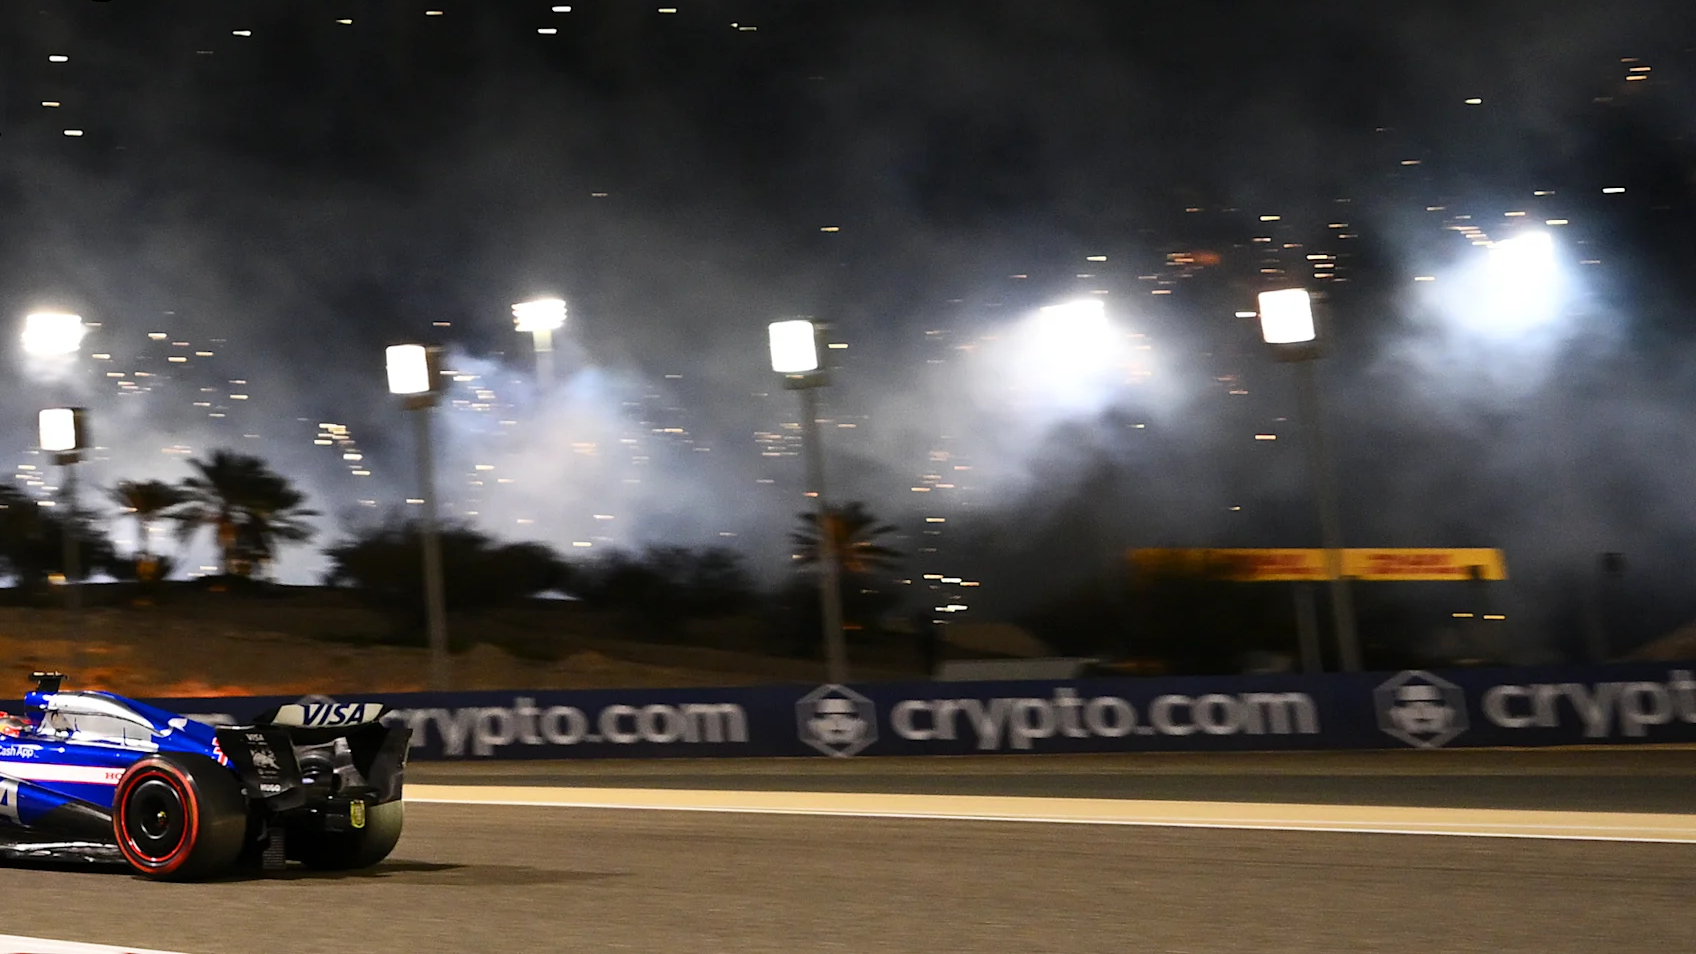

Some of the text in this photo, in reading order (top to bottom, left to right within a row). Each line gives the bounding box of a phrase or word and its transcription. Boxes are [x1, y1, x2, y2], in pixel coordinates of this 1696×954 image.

[304, 703, 365, 726] VISA
[891, 687, 1319, 749] crypto.com
[17, 747, 34, 758] App
